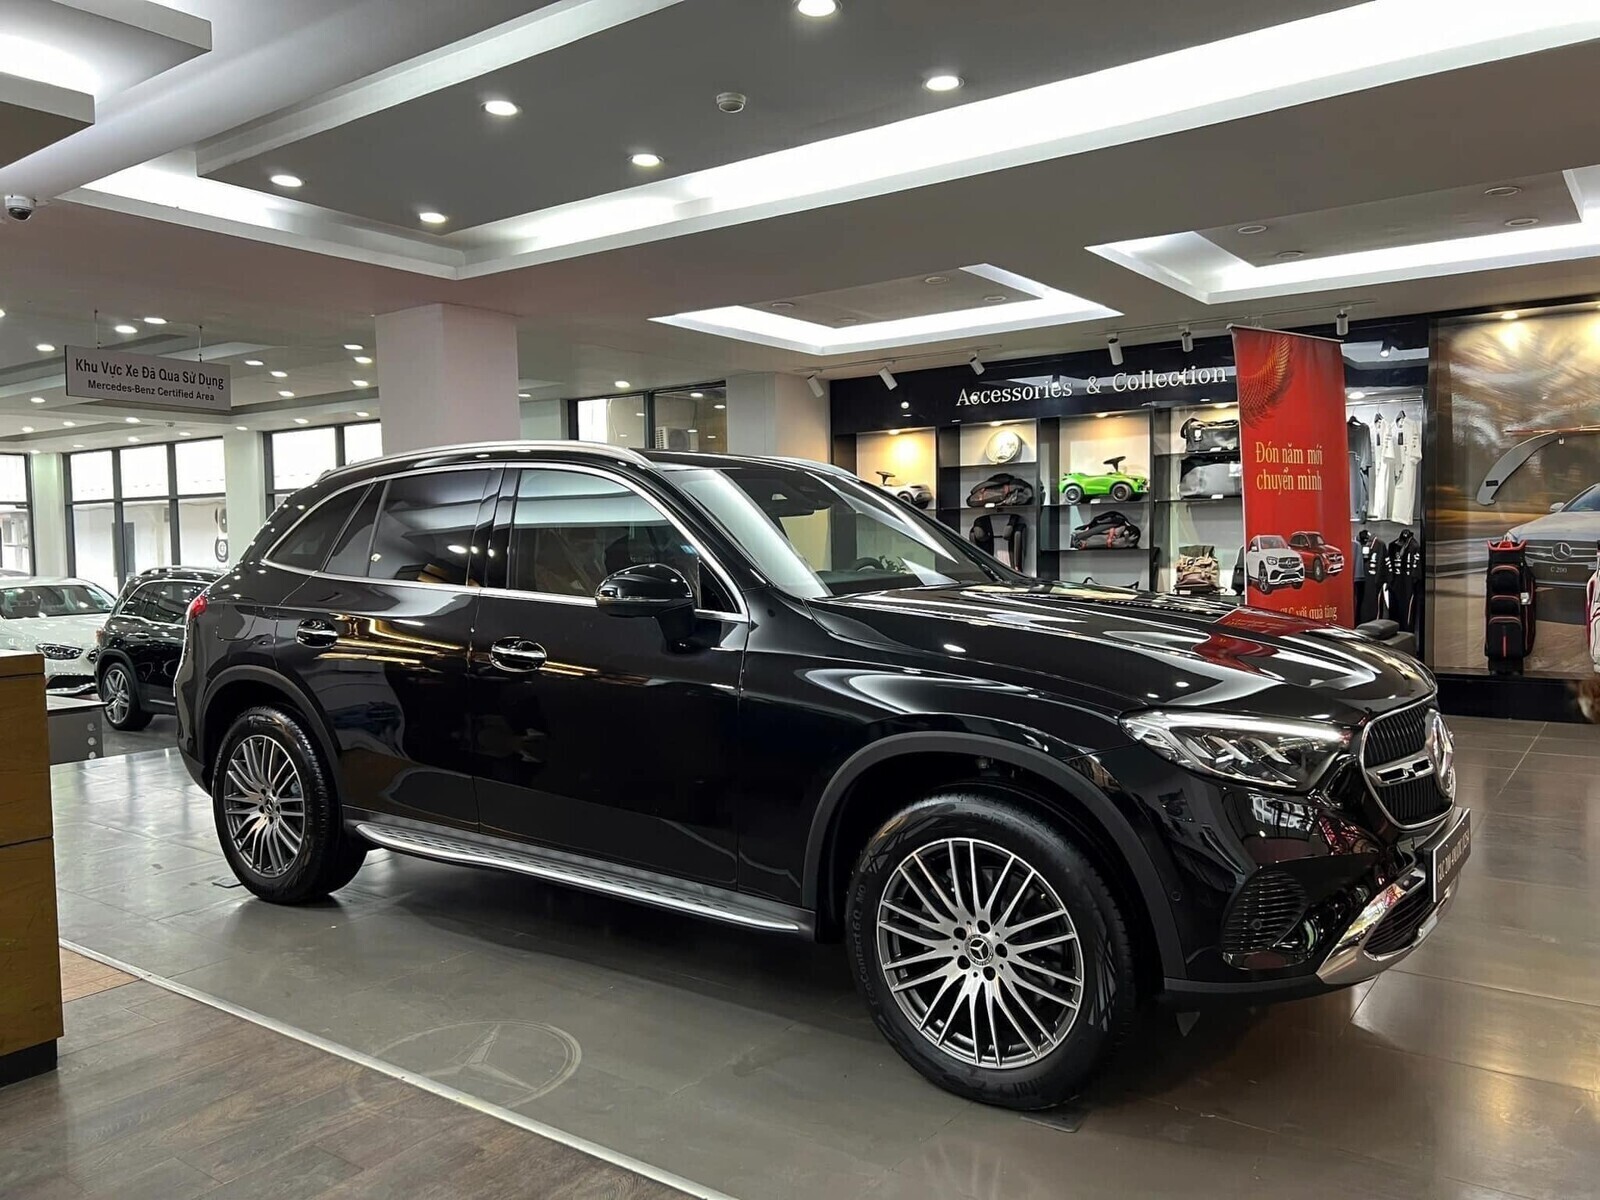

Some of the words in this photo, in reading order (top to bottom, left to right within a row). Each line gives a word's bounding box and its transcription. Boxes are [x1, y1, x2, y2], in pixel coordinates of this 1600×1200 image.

[75, 358, 98, 373] Khu
[101, 361, 123, 379] Vực
[125, 364, 139, 378] Xe
[142, 365, 156, 380] Đã
[158, 368, 180, 383] Qua
[182, 370, 197, 384] Sử
[199, 373, 224, 391] Dụng
[955, 380, 1073, 407] Accessories
[1086, 376, 1101, 395] &
[1112, 365, 1229, 393] Collection
[87, 380, 156, 396] Mercedes-Benz
[157, 386, 194, 399] Certified
[195, 390, 215, 402] Area
[1255, 441, 1279, 464] Đón
[1281, 442, 1304, 465] năm
[1307, 443, 1323, 465] mới
[1256, 466, 1295, 496] chuyển
[1297, 468, 1323, 491] mình
